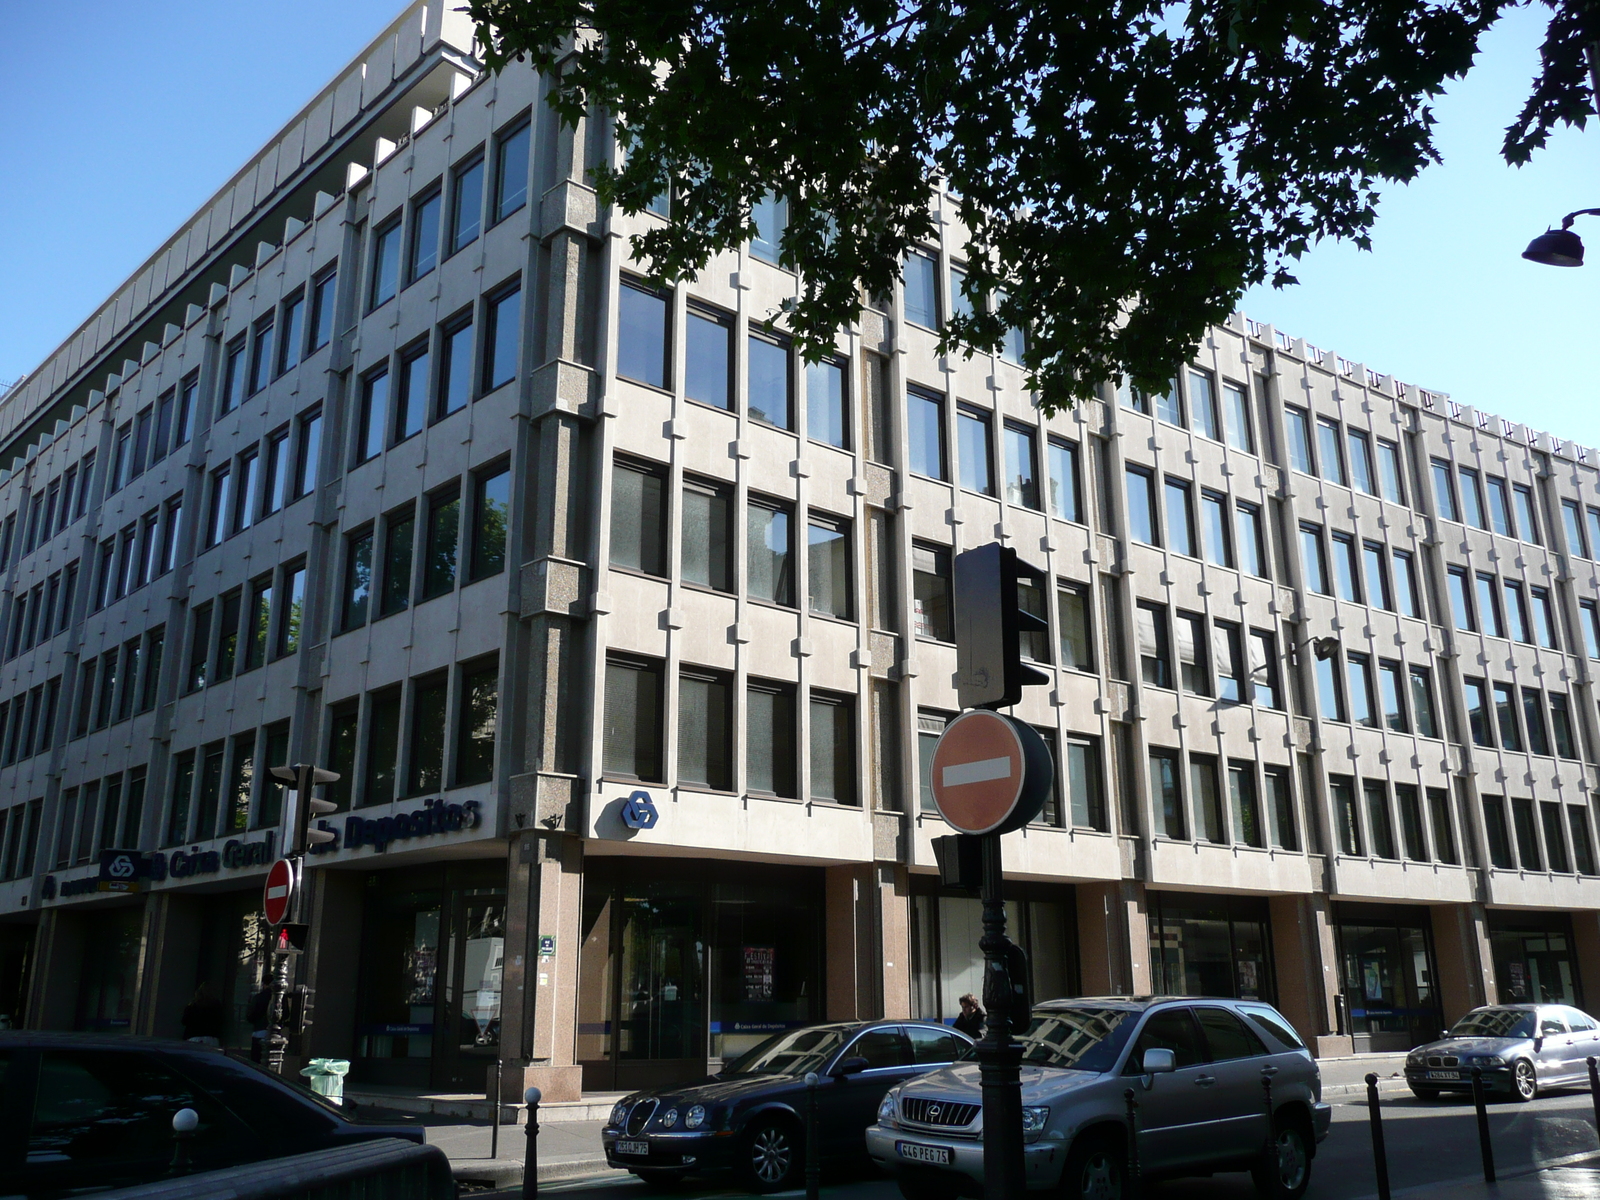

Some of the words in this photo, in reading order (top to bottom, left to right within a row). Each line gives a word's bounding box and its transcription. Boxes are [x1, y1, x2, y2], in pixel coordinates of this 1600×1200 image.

[170, 846, 219, 878] Caixa
[223, 831, 275, 869] Geral
[640, 1143, 648, 1154] 75
[903, 1145, 918, 1158] 646
[919, 1148, 934, 1161] PEG
[936, 1150, 947, 1163] 75
